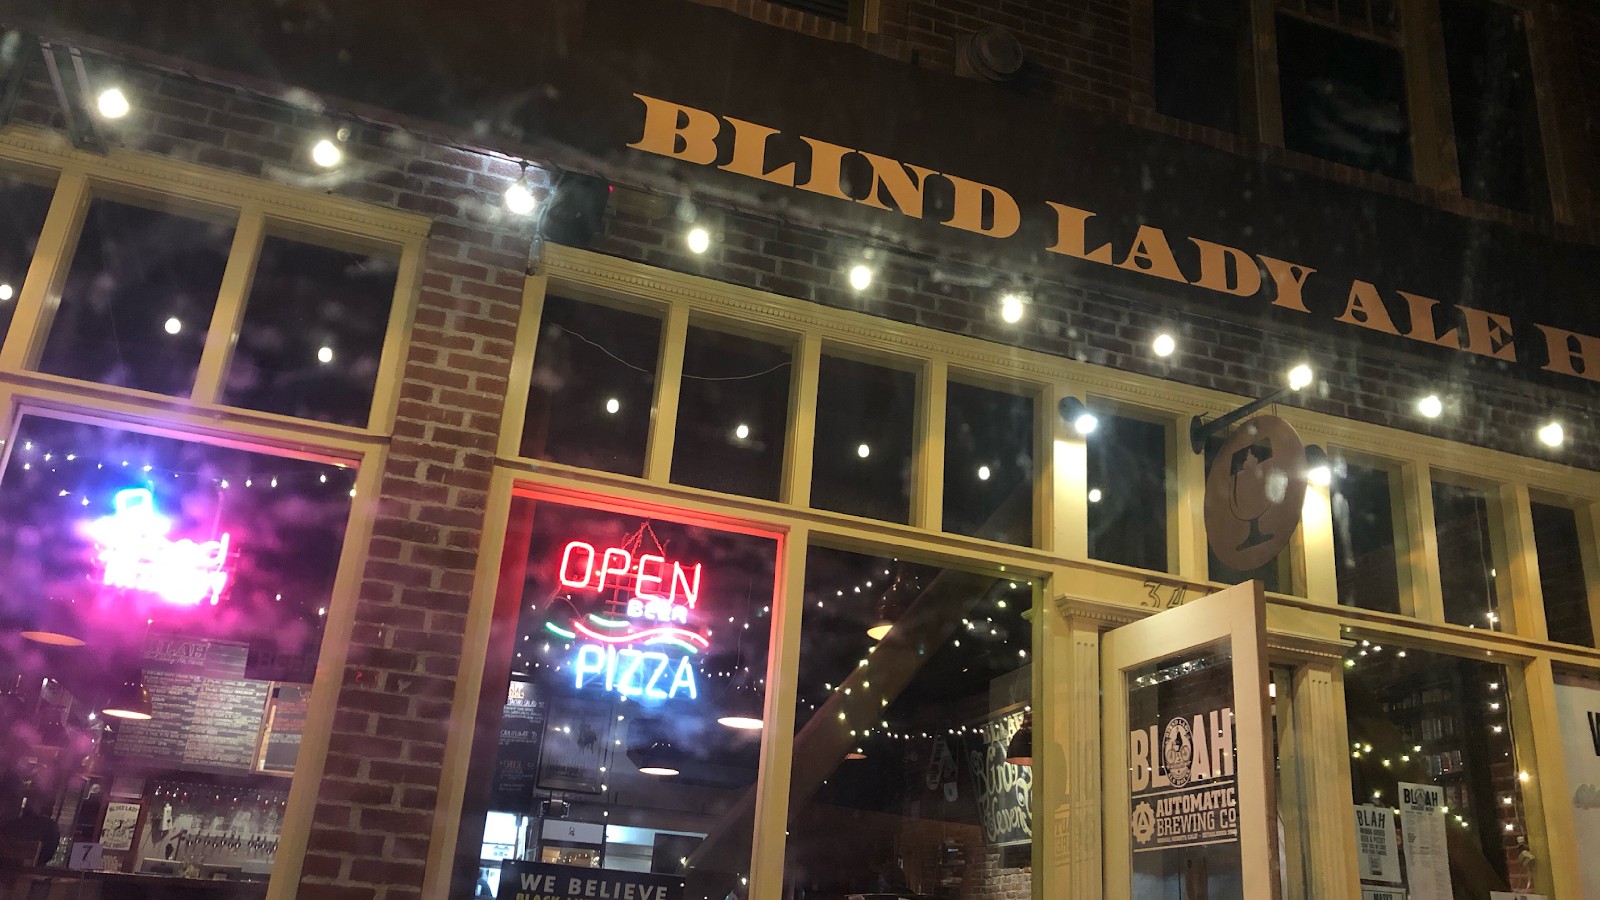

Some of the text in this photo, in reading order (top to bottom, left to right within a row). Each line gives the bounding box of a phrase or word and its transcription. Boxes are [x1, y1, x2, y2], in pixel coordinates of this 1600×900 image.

[626, 92, 1021, 240] BLIND
[1045, 200, 1317, 314] LADY
[1335, 279, 1518, 363] ALE
[559, 540, 703, 611] OPEN
[626, 598, 689, 624] BEER
[575, 643, 698, 700] PIZZA
[1156, 788, 1237, 814] AUTOMATIC
[1157, 813, 1215, 837] BREWING
[1356, 810, 1386, 829] BLAH
[520, 872, 668, 900] WE BELIEVE
